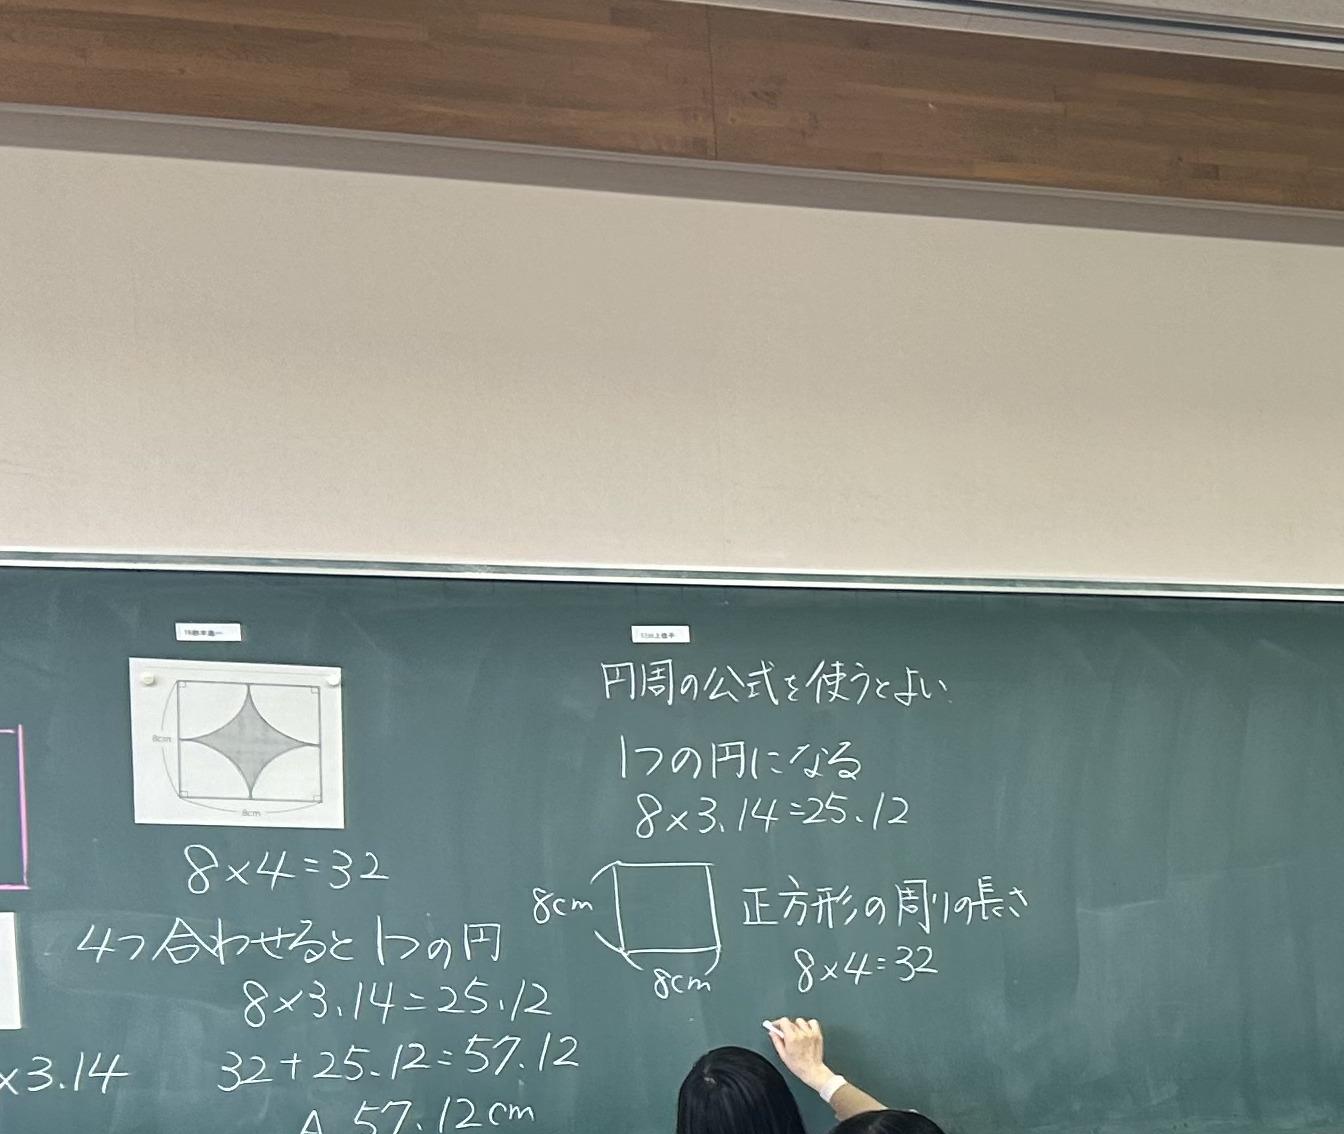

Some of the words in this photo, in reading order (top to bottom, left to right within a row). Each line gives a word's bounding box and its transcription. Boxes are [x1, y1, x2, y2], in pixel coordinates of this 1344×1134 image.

[619, 734, 864, 782] 1つの円になる
[531, 886, 595, 925] 8cm
[741, 873, 1030, 935] 正方形の周りの長さ
[653, 967, 712, 1000] 8cm
